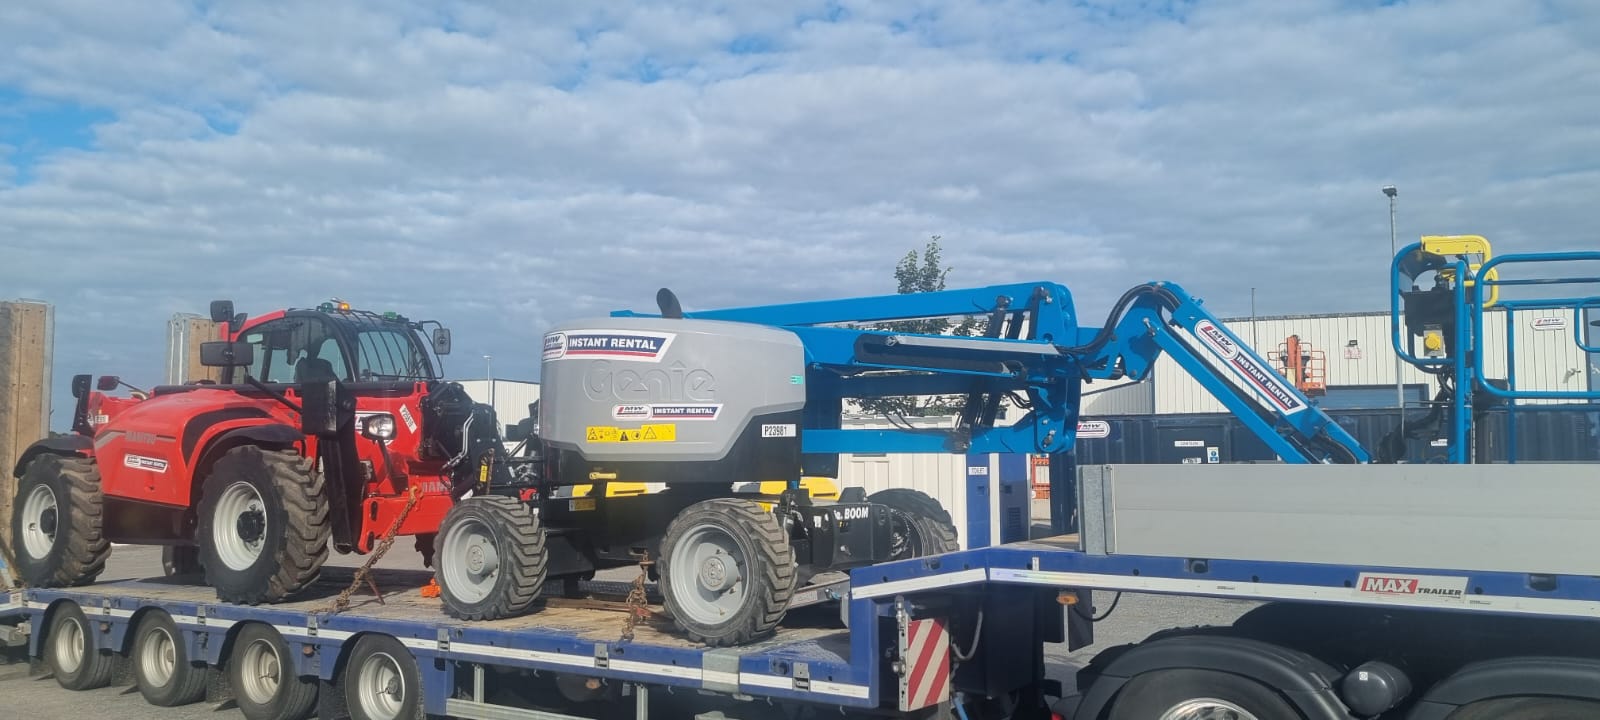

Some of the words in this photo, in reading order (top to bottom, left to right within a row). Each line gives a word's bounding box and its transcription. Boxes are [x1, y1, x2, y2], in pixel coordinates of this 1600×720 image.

[569, 338, 608, 348] INSTANT
[611, 338, 657, 350] RENTAL
[582, 359, 716, 401] Genie
[1237, 355, 1267, 386] INSTANT
[1265, 381, 1293, 408] RENTAL
[844, 506, 869, 520] BOOM
[1365, 578, 1412, 594] MAX
[1417, 587, 1462, 596] TRAILER
